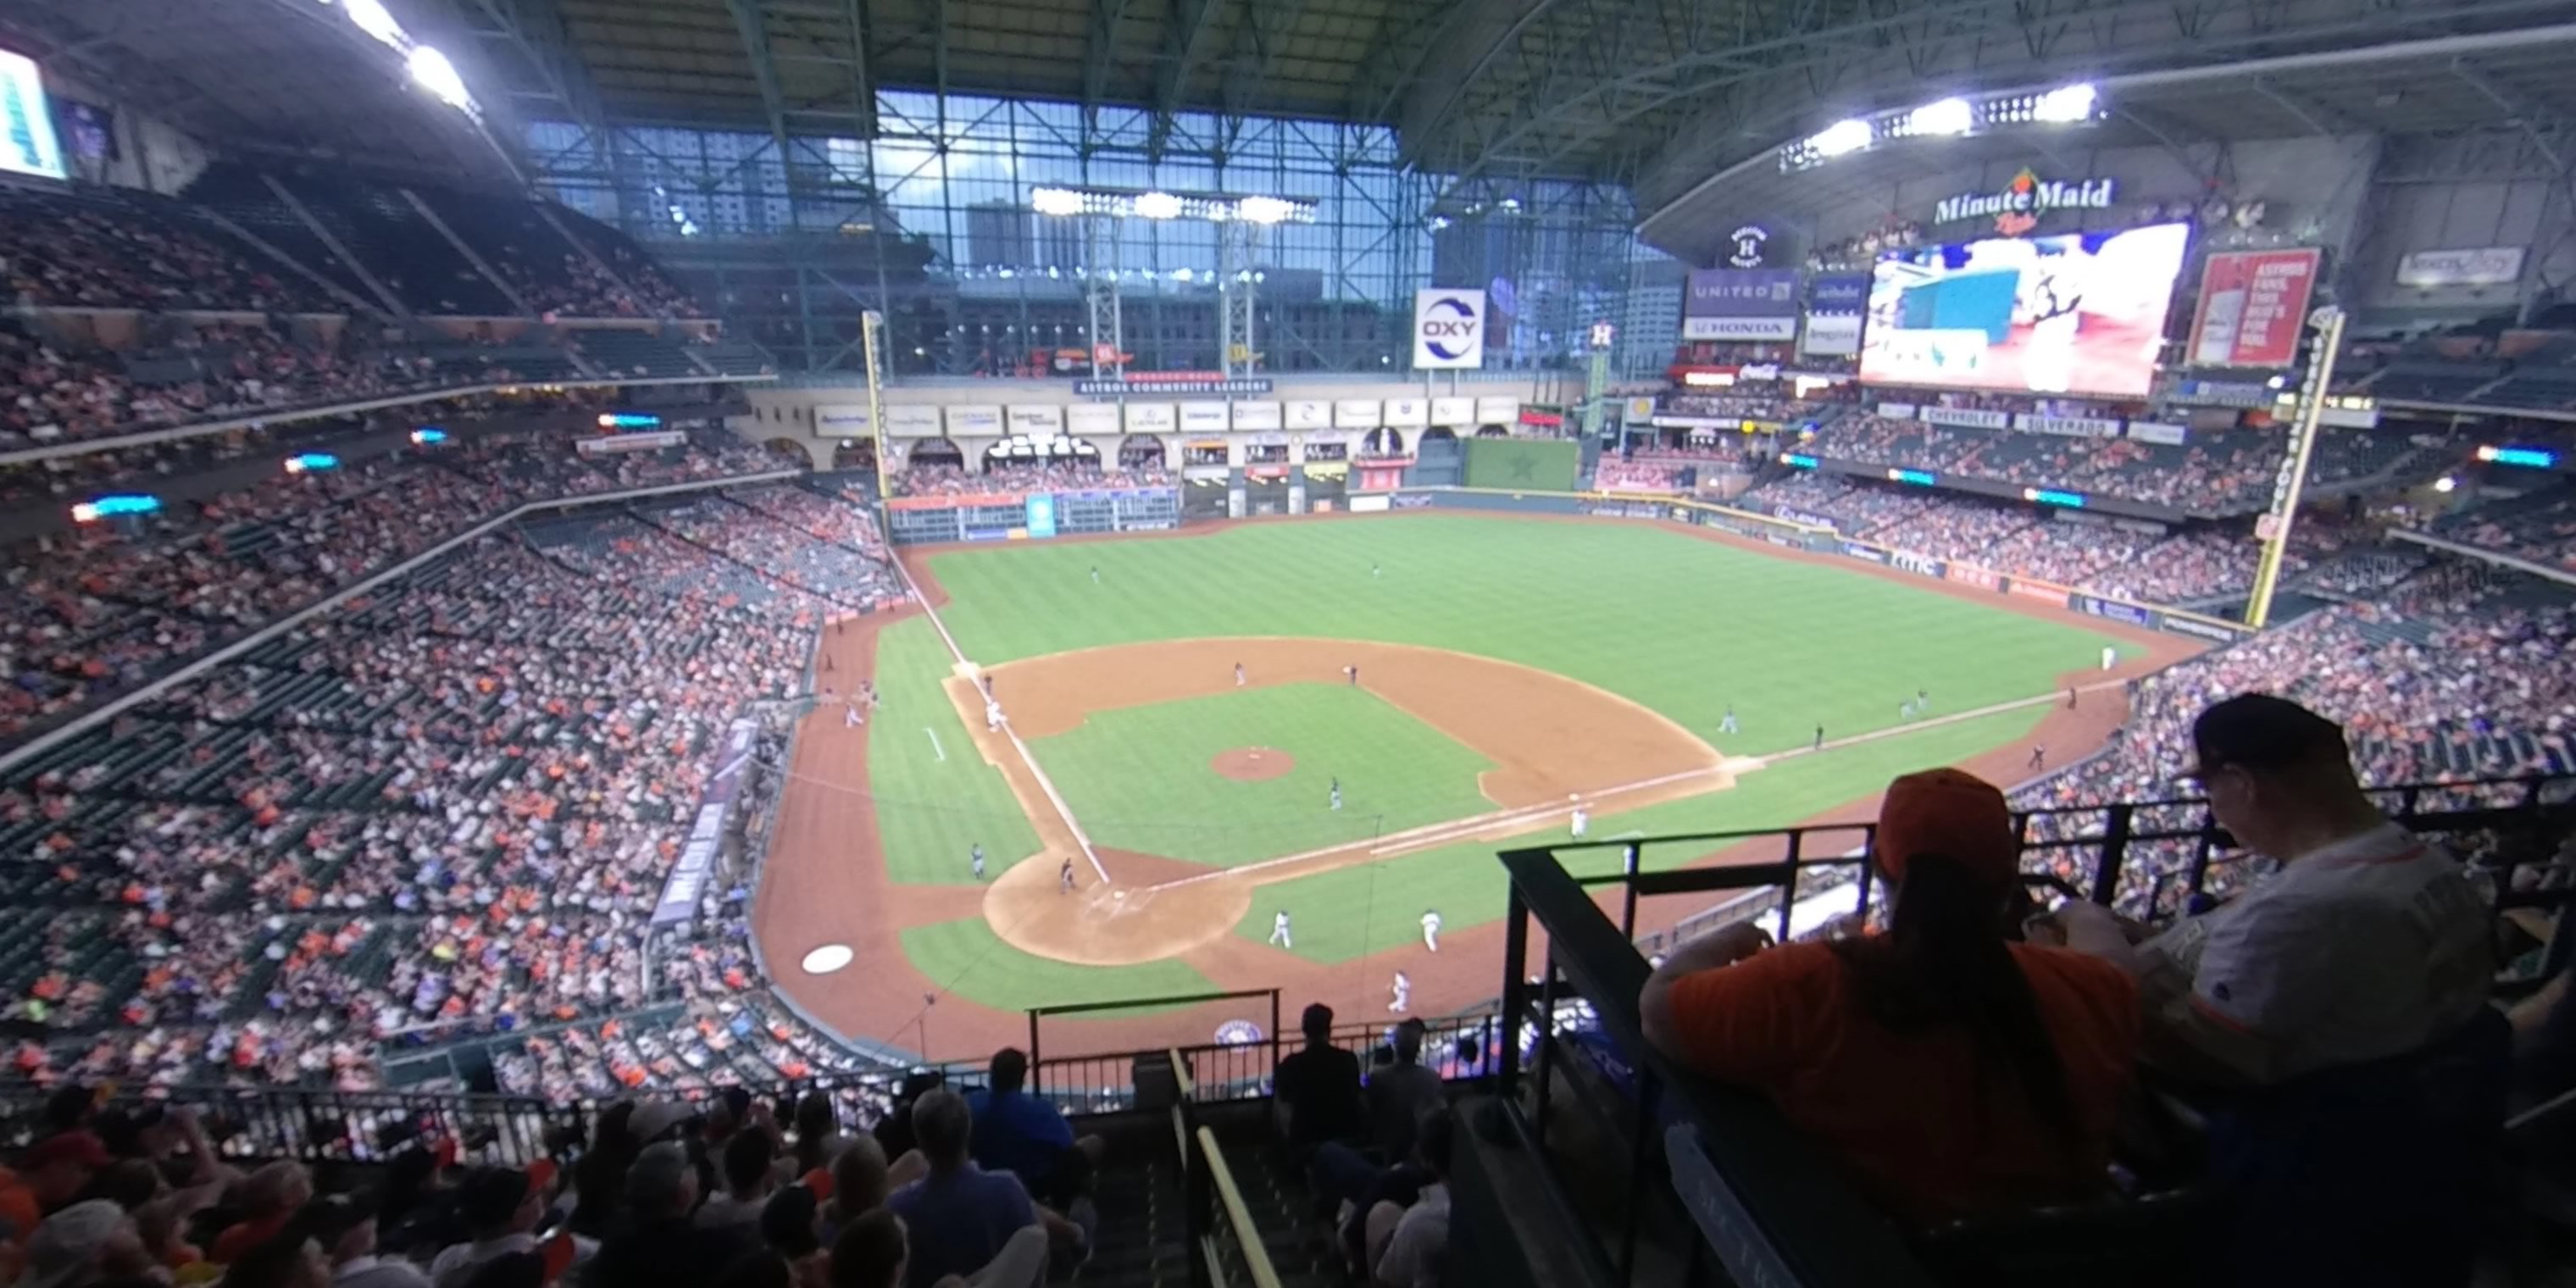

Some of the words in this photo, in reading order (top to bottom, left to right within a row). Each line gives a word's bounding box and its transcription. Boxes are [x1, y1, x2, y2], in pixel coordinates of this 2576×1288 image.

[1934, 189, 2031, 225] Minute
[2034, 177, 2113, 208] Maid
[1739, 238, 1757, 256] H
[1695, 286, 1768, 298] UNITED
[1423, 321, 1477, 336] OXY
[1591, 324, 1613, 345] H
[1710, 321, 1784, 334] HONDA
[1080, 382, 1129, 393] ASTROS
[1132, 382, 1210, 393] COMMUNITY
[1214, 381, 1267, 392] LEADERS
[1928, 410, 1998, 425] CHEVROLET
[2027, 418, 2106, 436] SILVERADO
